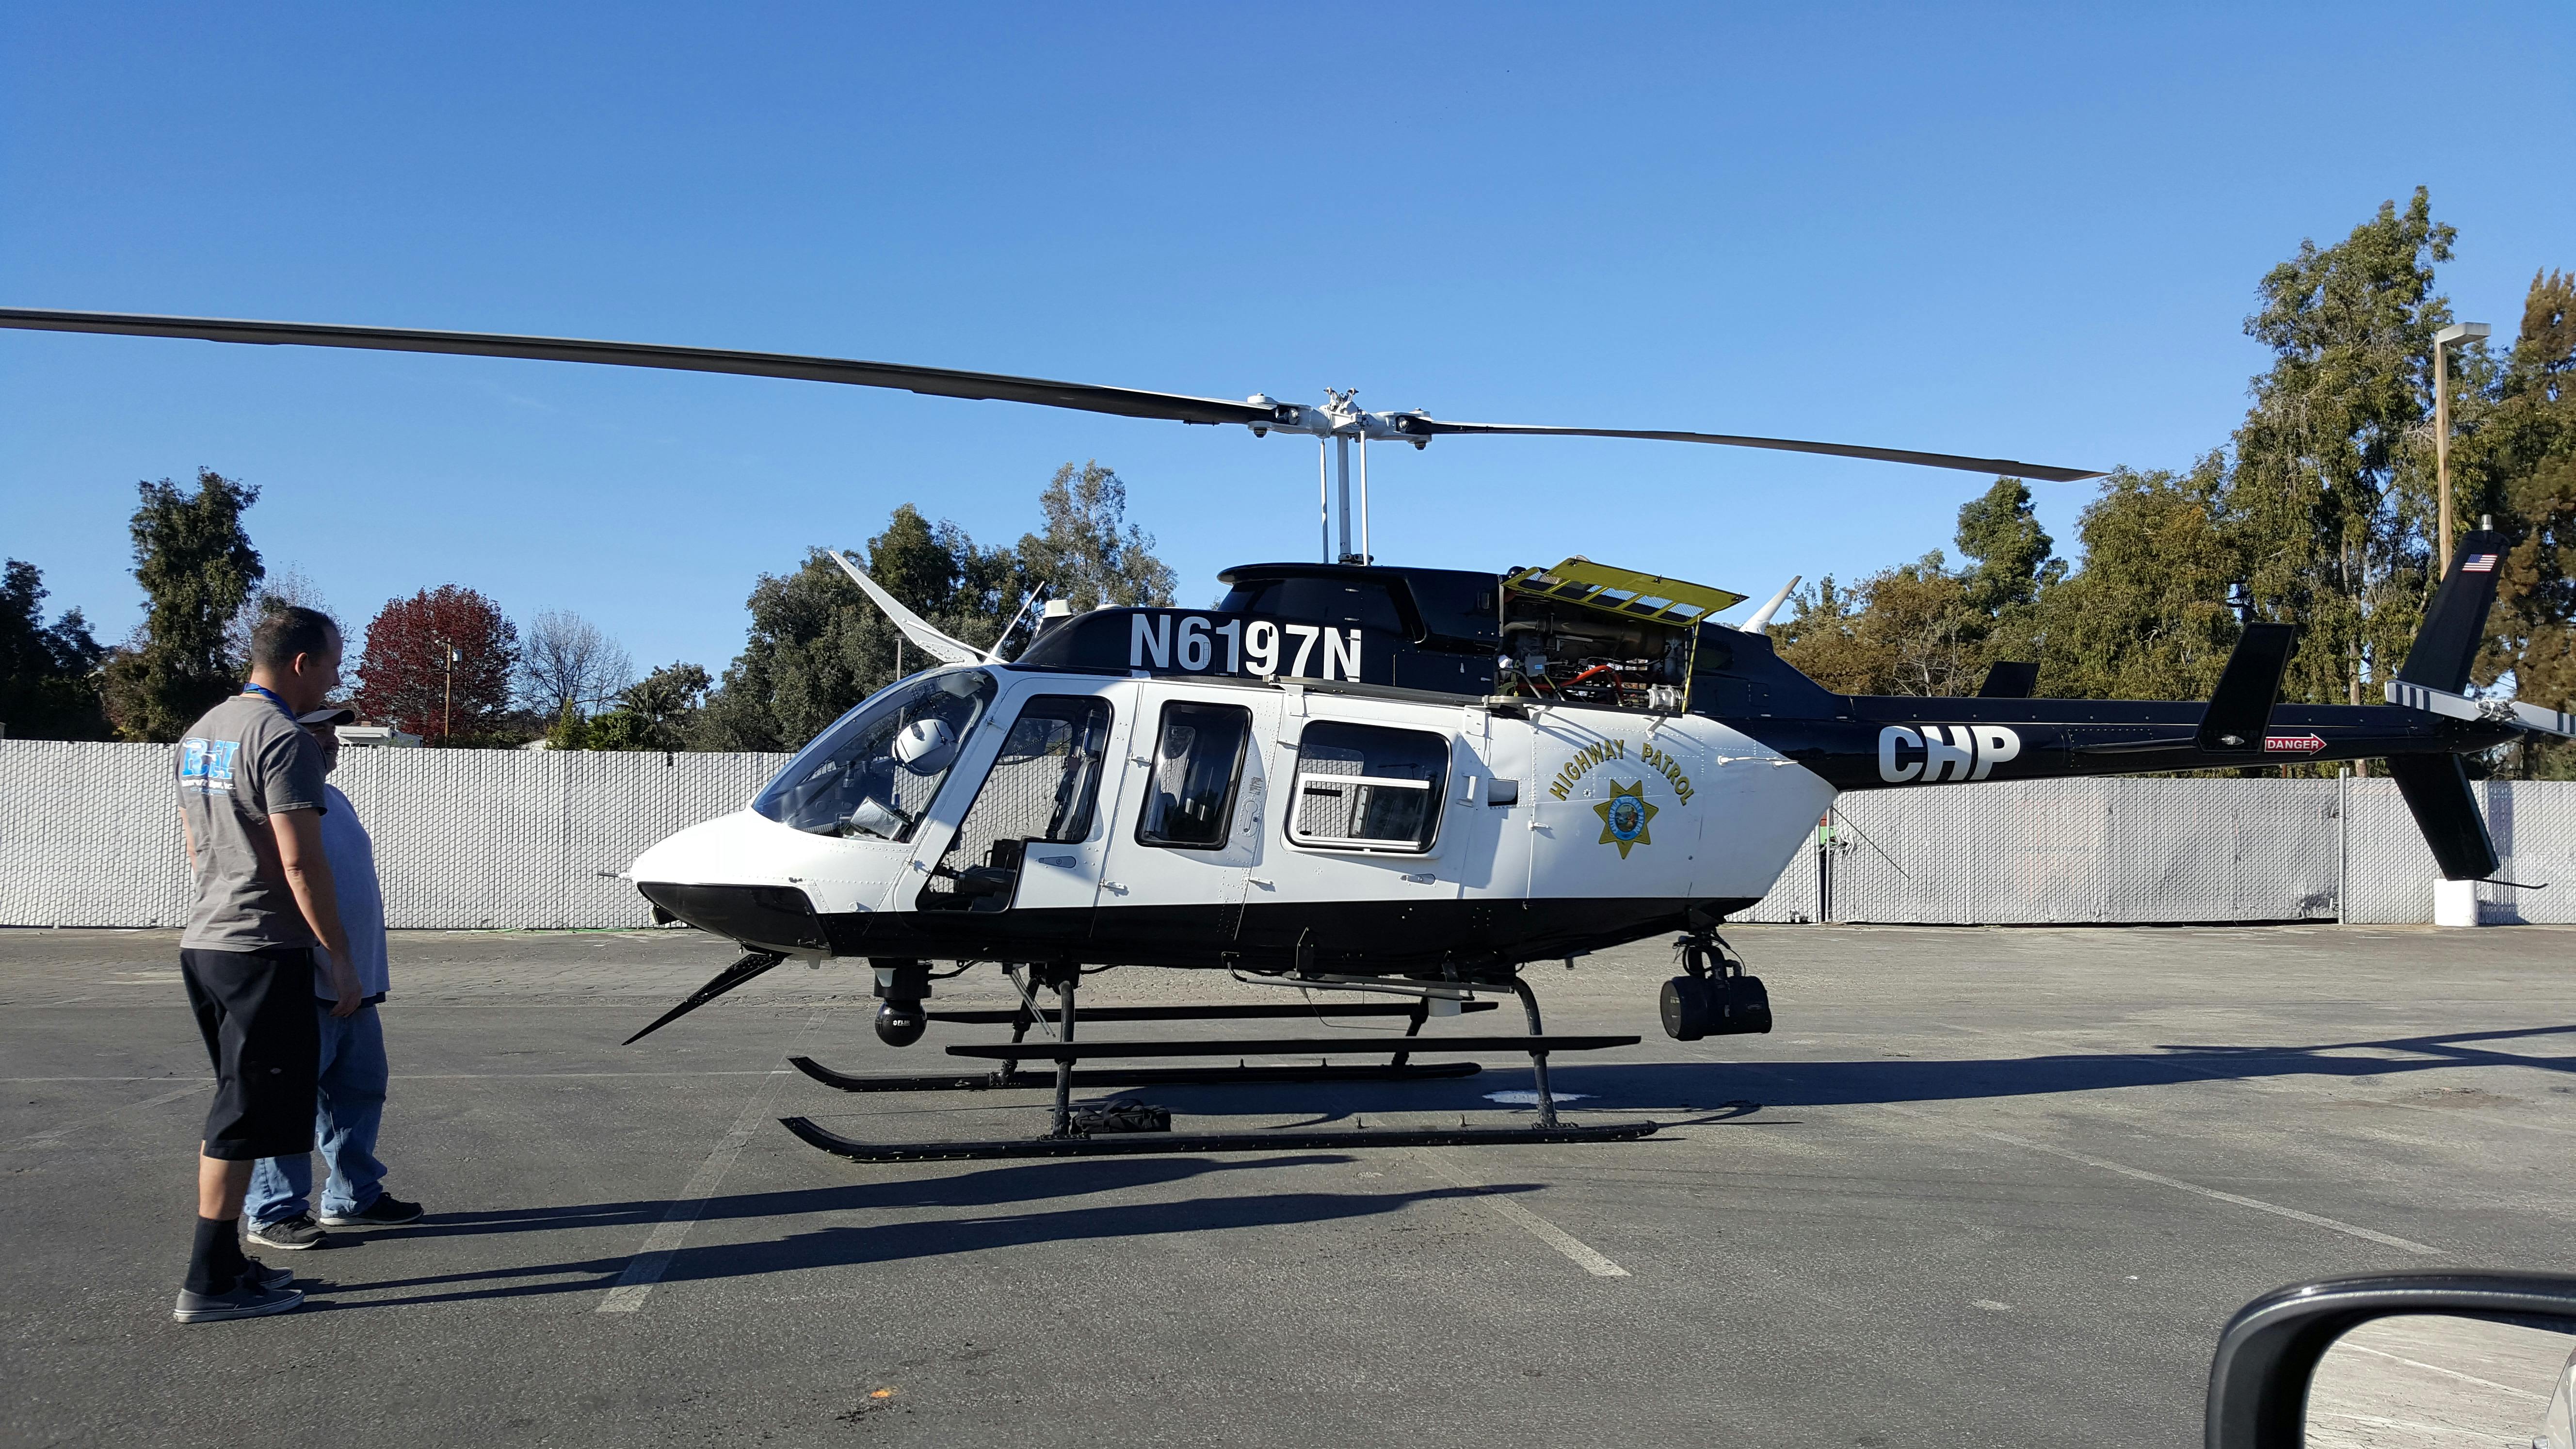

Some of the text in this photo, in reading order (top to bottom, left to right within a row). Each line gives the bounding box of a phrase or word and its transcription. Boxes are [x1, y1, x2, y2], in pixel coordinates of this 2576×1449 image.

[1130, 613, 1362, 683] N6197N
[1548, 739, 1694, 806] HIGHWAY PATROL
[1878, 725, 2021, 782] CHP
[2267, 740, 2319, 749] DANGER
